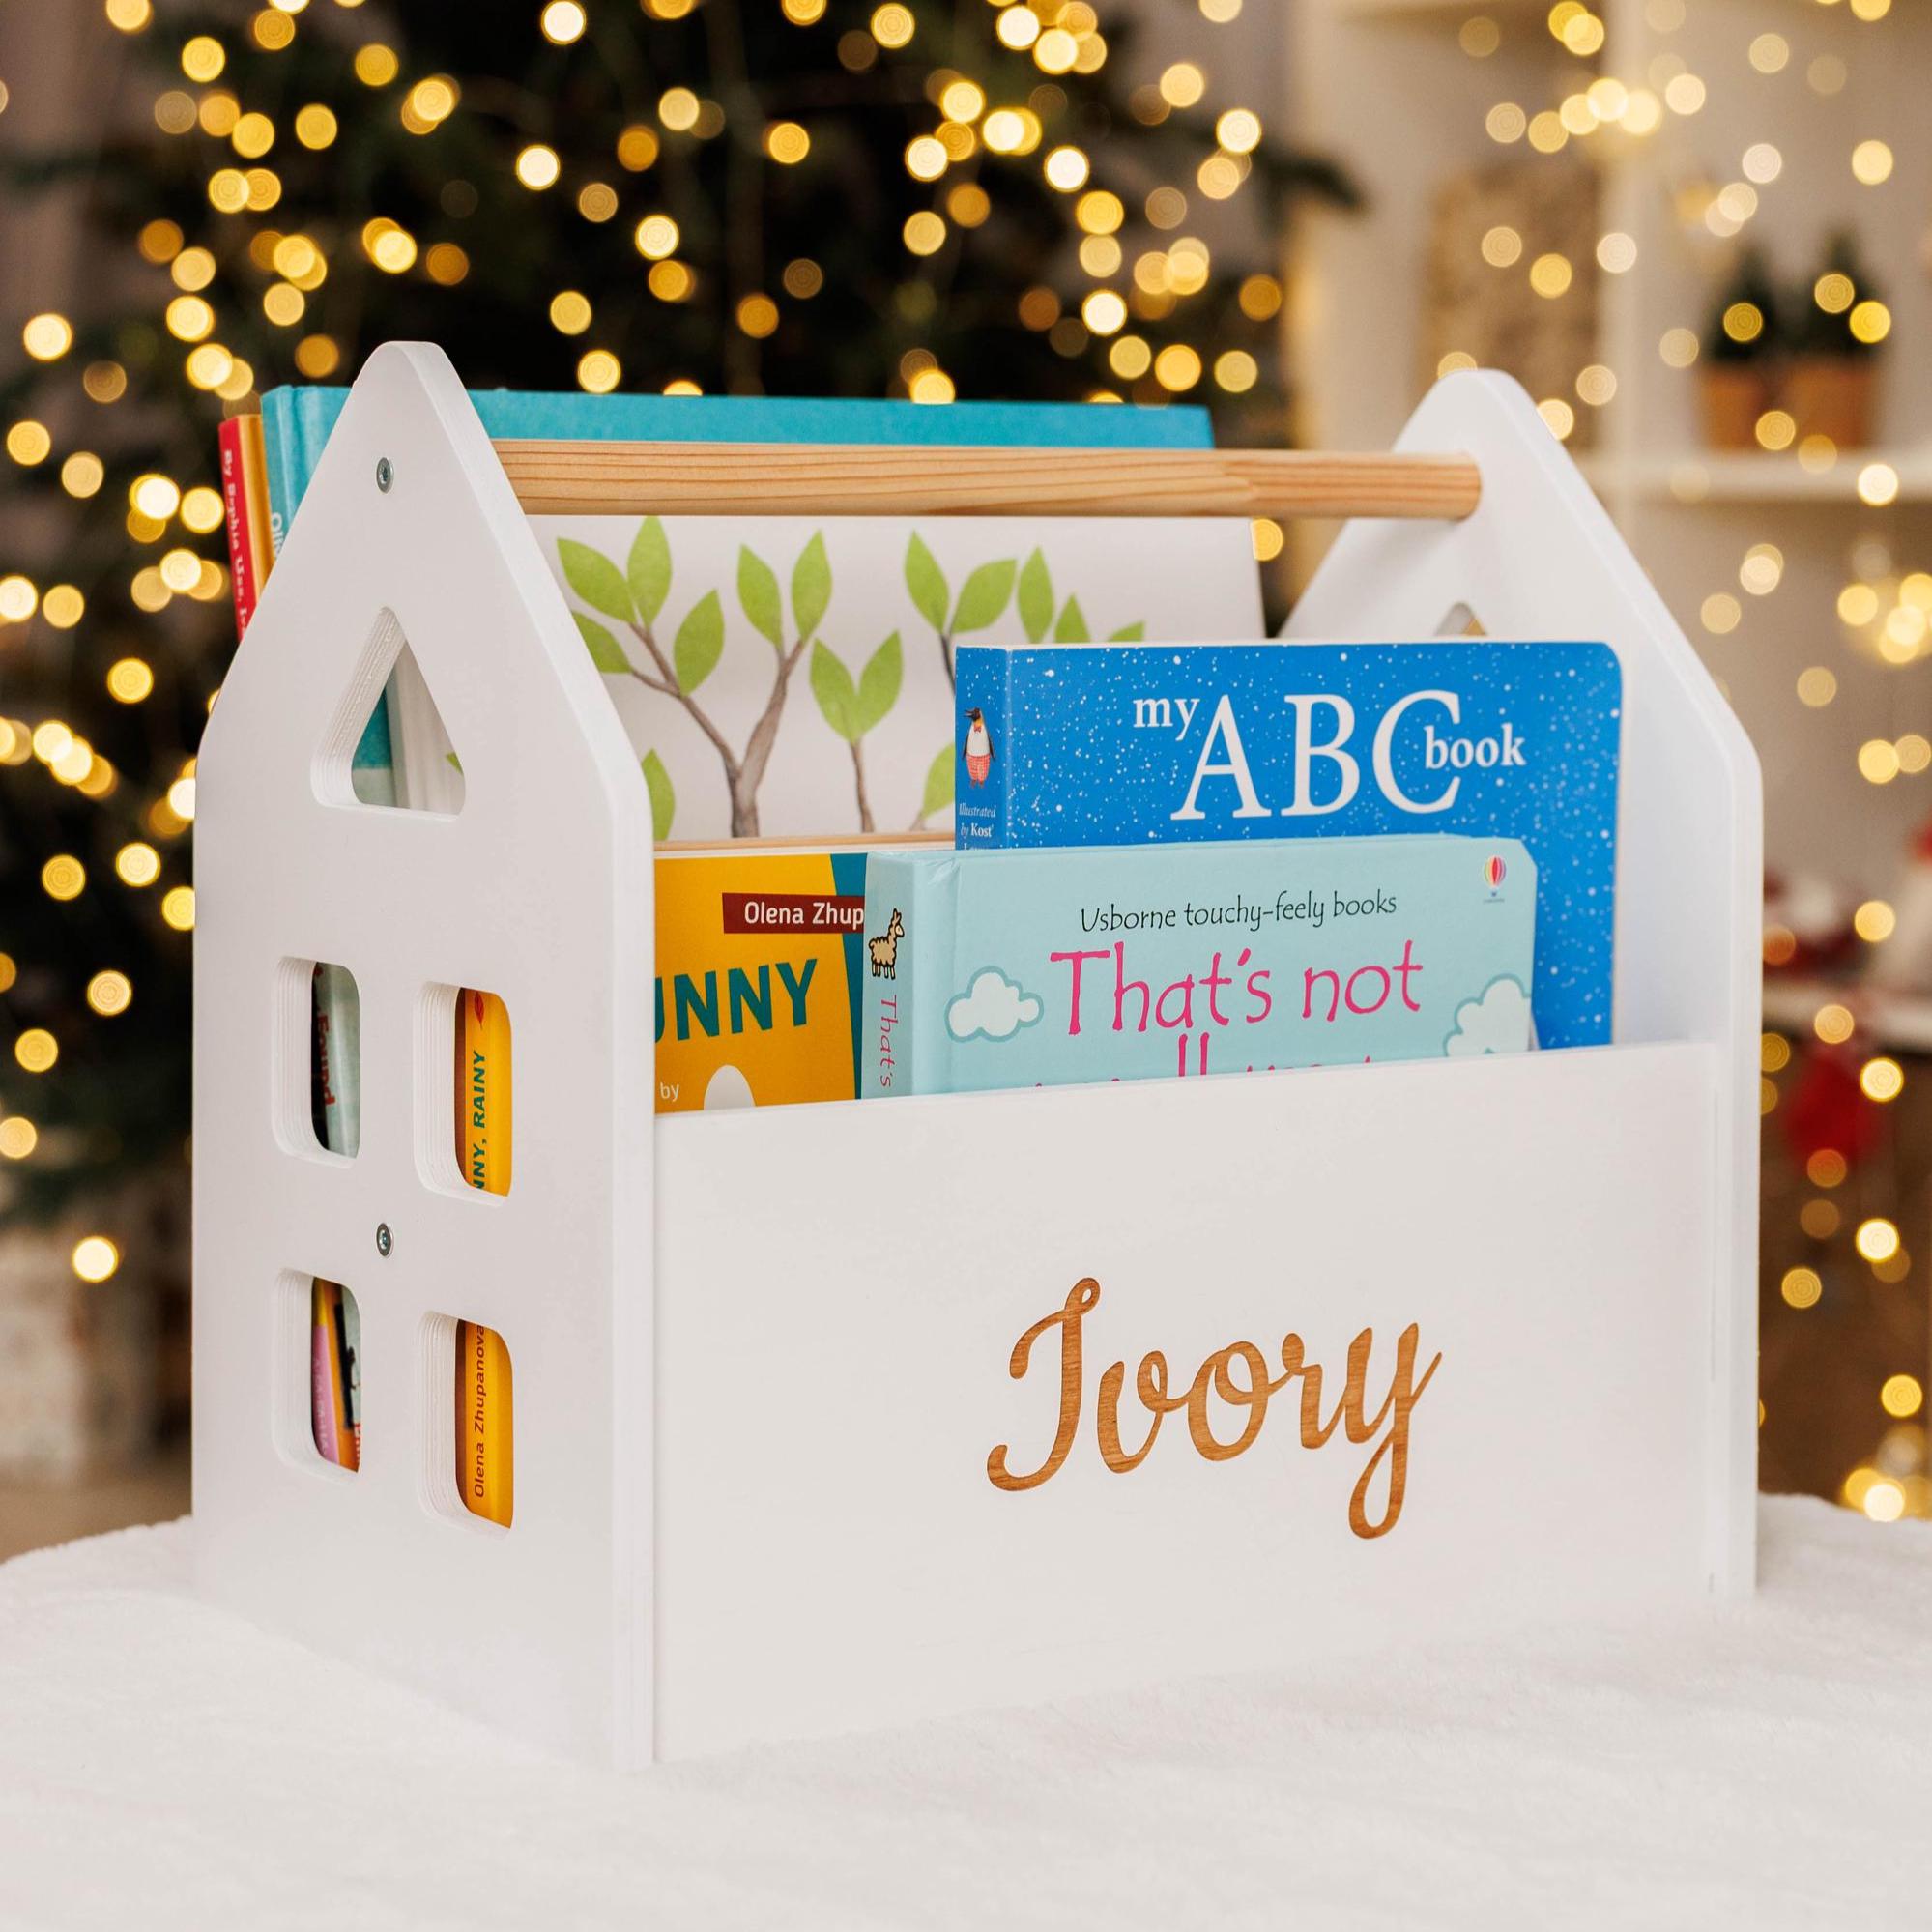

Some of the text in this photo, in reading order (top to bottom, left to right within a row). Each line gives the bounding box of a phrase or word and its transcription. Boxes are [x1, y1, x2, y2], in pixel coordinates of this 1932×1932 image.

[1133, 689, 1527, 821] my ABC book
[959, 802, 996, 818] Illustrated
[960, 822, 969, 840] by
[744, 901, 805, 925] Olena
[1080, 888, 1398, 933] Usborne touchy-feely books
[1050, 938, 1424, 1036] That's not
[880, 994, 899, 1088] That's
[473, 1050, 485, 1129] RAINY
[659, 1081, 680, 1102] by
[474, 1325, 487, 1498] Olena Zhupanova
[986, 1277, 1443, 1540] Ivory
